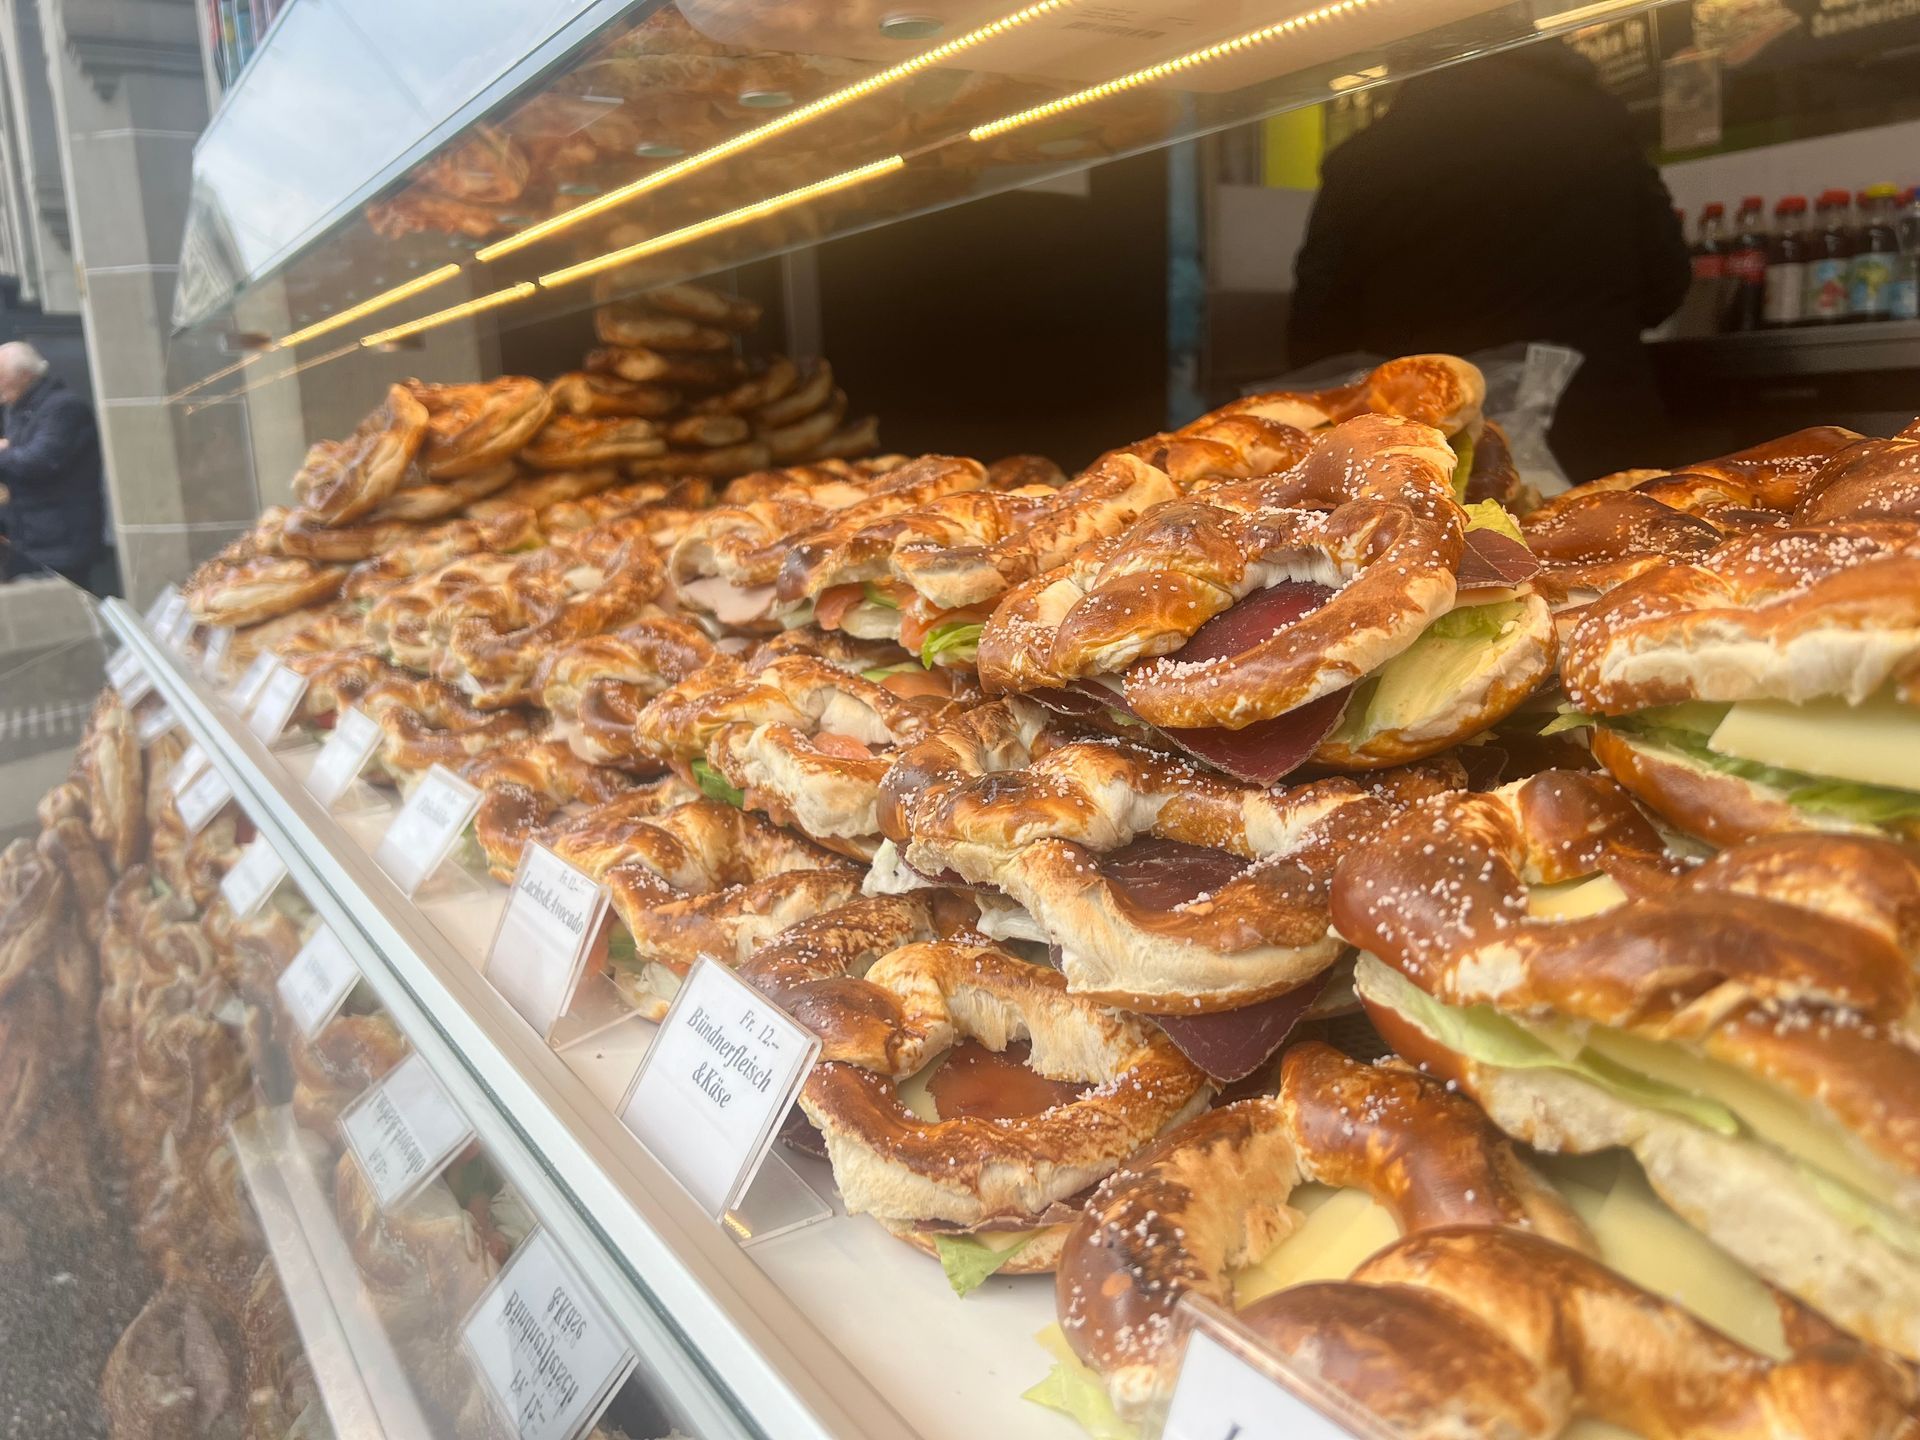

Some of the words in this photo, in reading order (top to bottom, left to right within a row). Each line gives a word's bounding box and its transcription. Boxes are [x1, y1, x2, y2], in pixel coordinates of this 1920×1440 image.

[739, 1009, 755, 1032] Fr.
[686, 1007, 774, 1094] Bündnerfleisch
[692, 1061, 732, 1108] &Käse
